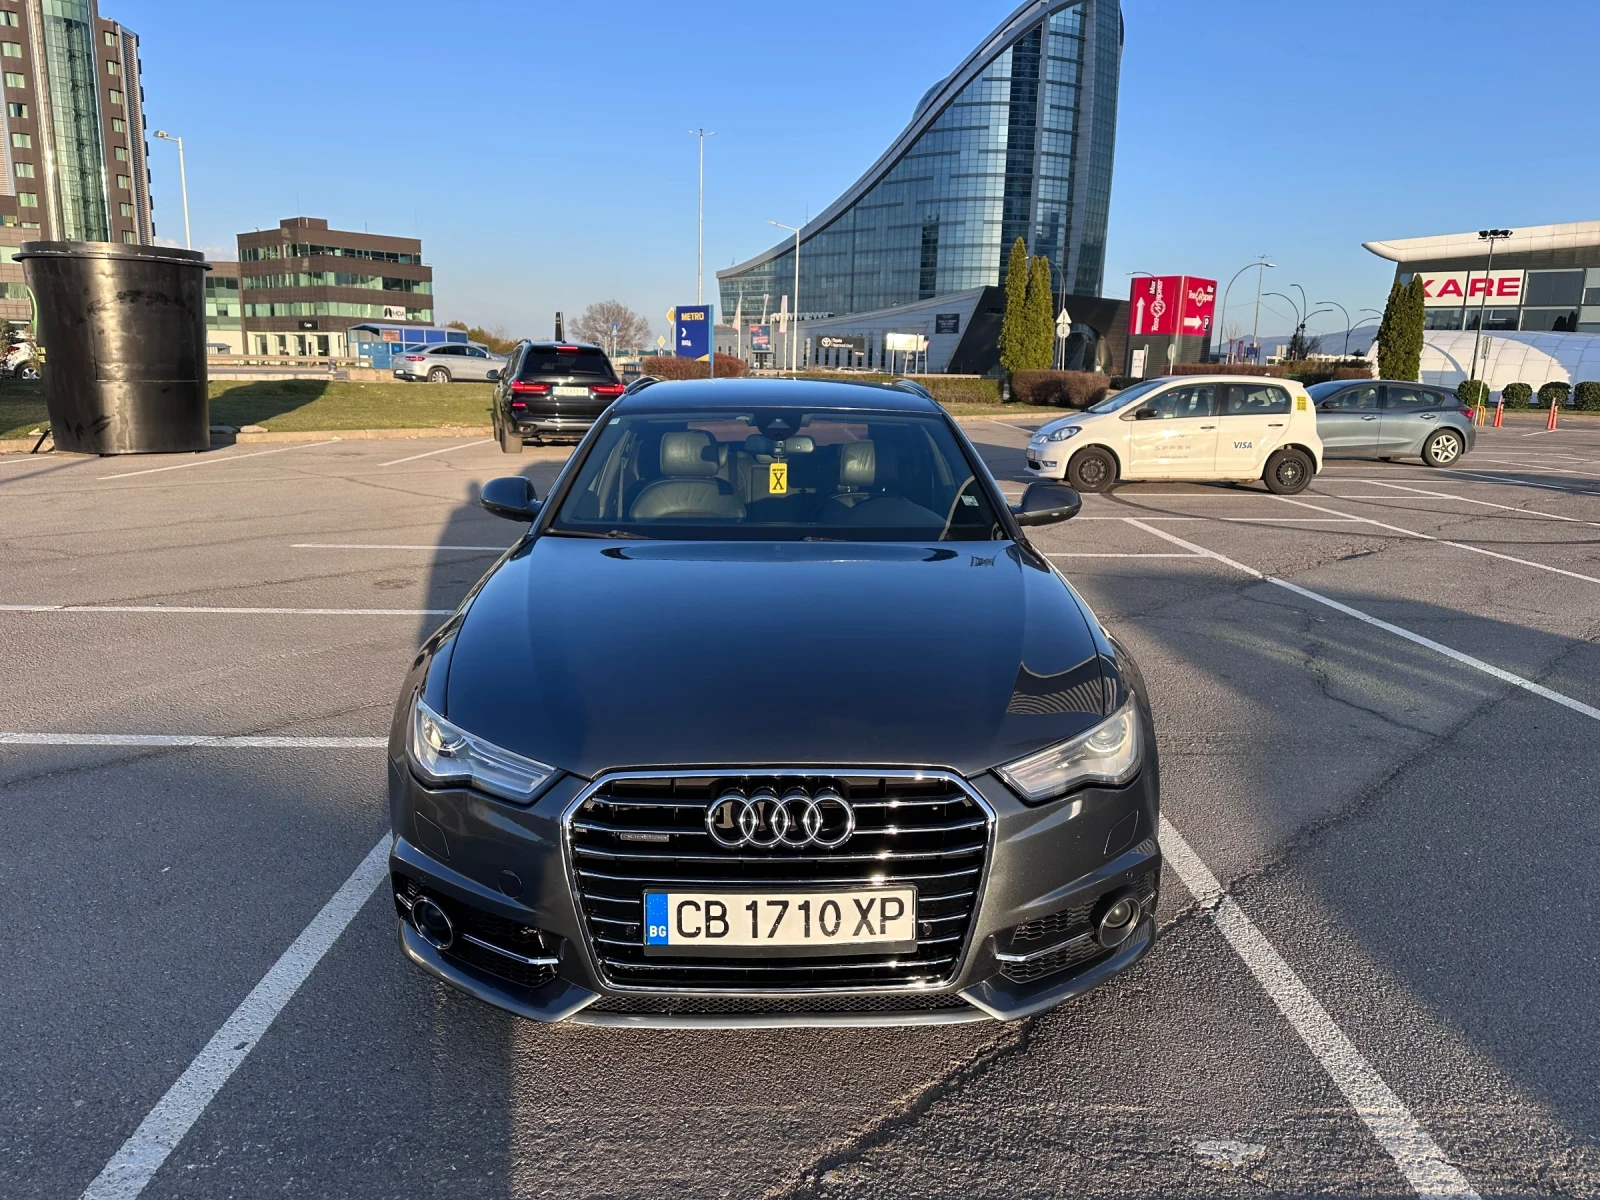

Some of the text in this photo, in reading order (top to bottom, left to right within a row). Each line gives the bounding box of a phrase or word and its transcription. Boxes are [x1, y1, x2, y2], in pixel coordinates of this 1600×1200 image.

[681, 311, 704, 321] METRO
[1233, 441, 1253, 449] VISA
[772, 472, 785, 490] X
[676, 897, 905, 939] CB 1710 XP
[650, 925, 667, 937] BG
